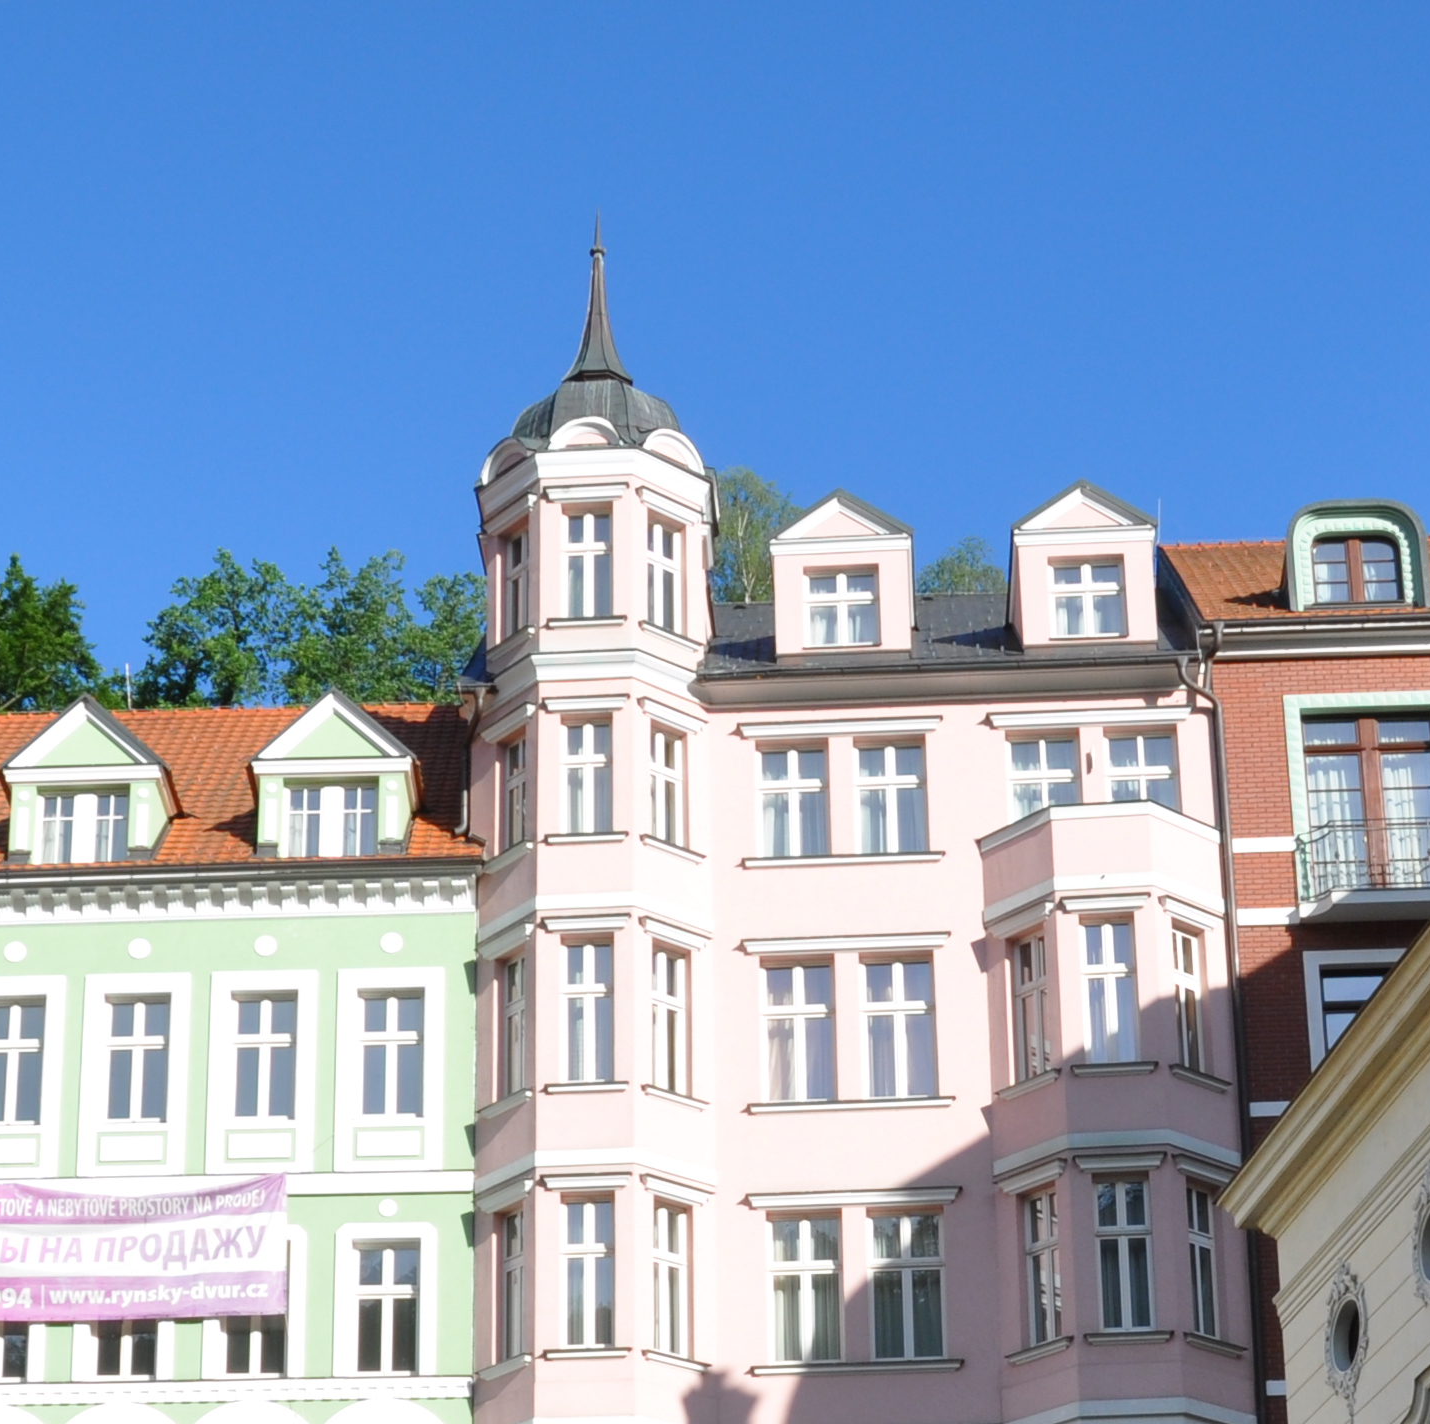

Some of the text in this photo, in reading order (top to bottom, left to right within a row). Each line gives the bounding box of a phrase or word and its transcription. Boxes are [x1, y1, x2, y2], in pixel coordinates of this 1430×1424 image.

[35, 1199, 44, 1216] A
[48, 1196, 115, 1217] NEBYTOVÉ
[119, 1197, 189, 1217] PROSTORY
[193, 1197, 212, 1214] NA
[215, 1189, 265, 1210] PRODEJ
[38, 1236, 83, 1263] НА
[94, 1225, 266, 1271] ПРОДАЖУ
[49, 1281, 269, 1307] www.rynsky-dvur.cz
